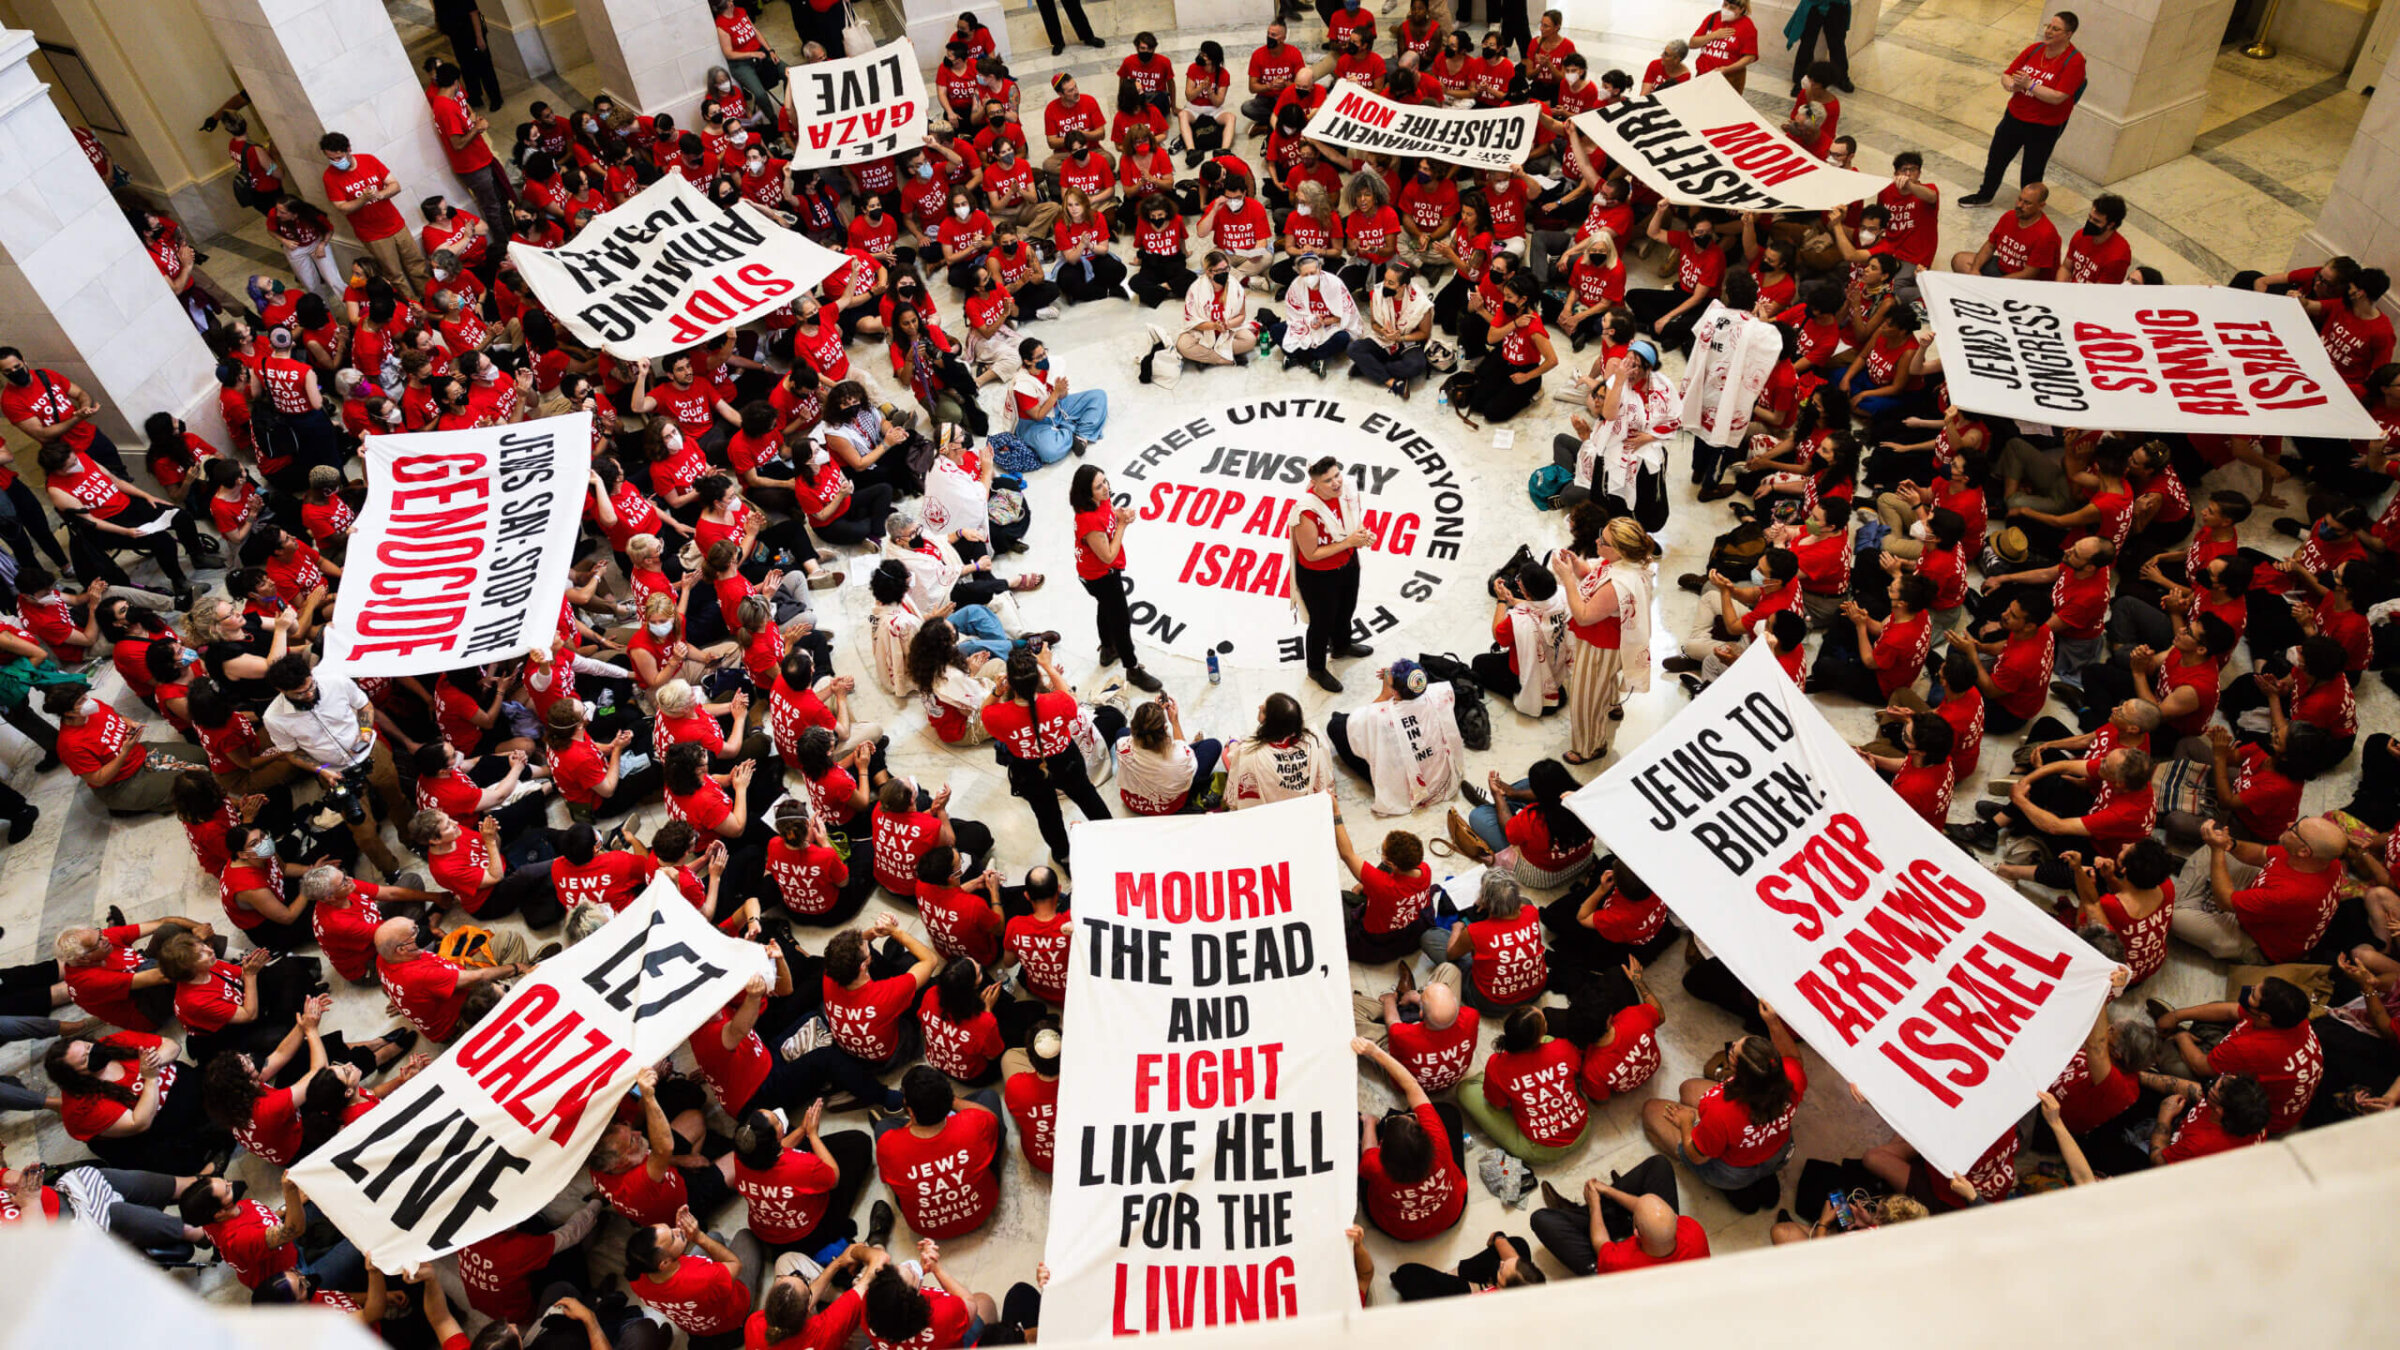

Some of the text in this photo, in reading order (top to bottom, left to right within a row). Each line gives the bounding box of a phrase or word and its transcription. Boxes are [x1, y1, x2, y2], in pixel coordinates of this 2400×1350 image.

[812, 54, 904, 116] LIVE
[2021, 65, 2053, 81] NOT IN
[807, 101, 914, 149] GAZA
[1077, 113, 1087, 121] IN
[1335, 91, 1397, 129] NOW
[1395, 114, 1525, 150] CEASEFIRE
[1701, 122, 1818, 186] NOW
[345, 175, 378, 193] NOT IN
[1223, 223, 1252, 232] STOP
[1417, 209, 1439, 219] OUR
[1144, 230, 1175, 241] NOT IN
[1147, 239, 1172, 249] OUR
[1294, 229, 1315, 237] NOT
[2002, 235, 2026, 252] STOP
[577, 209, 766, 342] ARMING
[1581, 284, 1602, 296] OUR
[669, 263, 795, 343] STOP
[1949, 298, 2022, 390] JEWS TO
[2003, 300, 2089, 412] CONGRESS
[2073, 321, 2157, 394] STOP
[2350, 336, 2364, 349] IN
[1882, 360, 1892, 372] IN
[2135, 308, 2249, 416] ARMING
[2213, 320, 2328, 410] ISRAEL
[675, 399, 693, 409] NOT
[680, 406, 703, 418] OUR
[1227, 399, 1346, 425] UNTIL
[499, 433, 554, 492] JEWS
[757, 440, 776, 461] STOP
[1122, 417, 1216, 481] FREE
[72, 471, 101, 497] NOT IN
[1200, 446, 1400, 496] JEWS AY
[84, 479, 109, 501] OUR
[819, 483, 832, 501] NOT
[1359, 412, 1464, 562] EVERYONE
[1140, 481, 1246, 530] STOP
[345, 453, 490, 661] GENOCIDE
[1178, 541, 1292, 598] ISRA
[481, 546, 543, 608] STOP
[1400, 570, 1443, 602] IS
[460, 608, 526, 658] THE
[1127, 600, 1187, 644] NO
[770, 690, 800, 720] JEWS
[100, 713, 115, 745] STOP
[1630, 691, 1795, 832] JEWS TO
[877, 815, 921, 838] JEWS
[877, 829, 913, 852] SAY
[559, 874, 611, 890] JEWS
[771, 859, 821, 877] JEWS
[778, 872, 814, 889] SAY
[1755, 811, 1885, 942] STOP
[917, 895, 958, 921] JEWS
[1115, 861, 1293, 925] MOURN
[2122, 903, 2173, 935] JEWS
[1012, 935, 1066, 949] JEWS
[1489, 921, 1540, 949] JEWS
[582, 910, 728, 1022] LET
[1018, 949, 1059, 962] SAY
[1083, 917, 1329, 988] THE DEAD,
[1496, 954, 1543, 976] STOP
[1499, 939, 1539, 964] SAY
[1794, 859, 1987, 1048] ARMING
[825, 1000, 877, 1021] JEWS
[922, 1010, 971, 1041] JEWS
[1167, 995, 1249, 1043] AND
[1878, 931, 2073, 1109] ISRAEL
[829, 1018, 870, 1036] SAY
[925, 1025, 960, 1052] SAY
[456, 983, 632, 1148] GAZA
[1412, 1039, 1471, 1067] JEWS
[1420, 1056, 1466, 1079] SAY
[1607, 1033, 1651, 1085] JEWS
[1134, 1043, 1283, 1113] FIGHT
[1510, 1061, 1569, 1093] JEWS
[1521, 1079, 1566, 1105] SAY
[1525, 1090, 1575, 1118] STOP
[1529, 1097, 1580, 1129] ARMING
[1533, 1108, 1587, 1141] ISRAEL
[907, 1148, 970, 1180] JEWS
[1079, 1111, 1334, 1187] LIKE HELL
[331, 1084, 531, 1251] LIVE
[918, 1169, 966, 1196] SAY
[739, 1179, 794, 1199] JEWS
[918, 1184, 970, 1209] STOP
[1391, 1168, 1446, 1200] JEWS
[918, 1192, 979, 1218] ARMING
[920, 1202, 983, 1229] ISRAEL
[1119, 1191, 1293, 1250] FOR THE
[460, 1247, 493, 1270] TOP
[1112, 1255, 1298, 1337] LIVING
